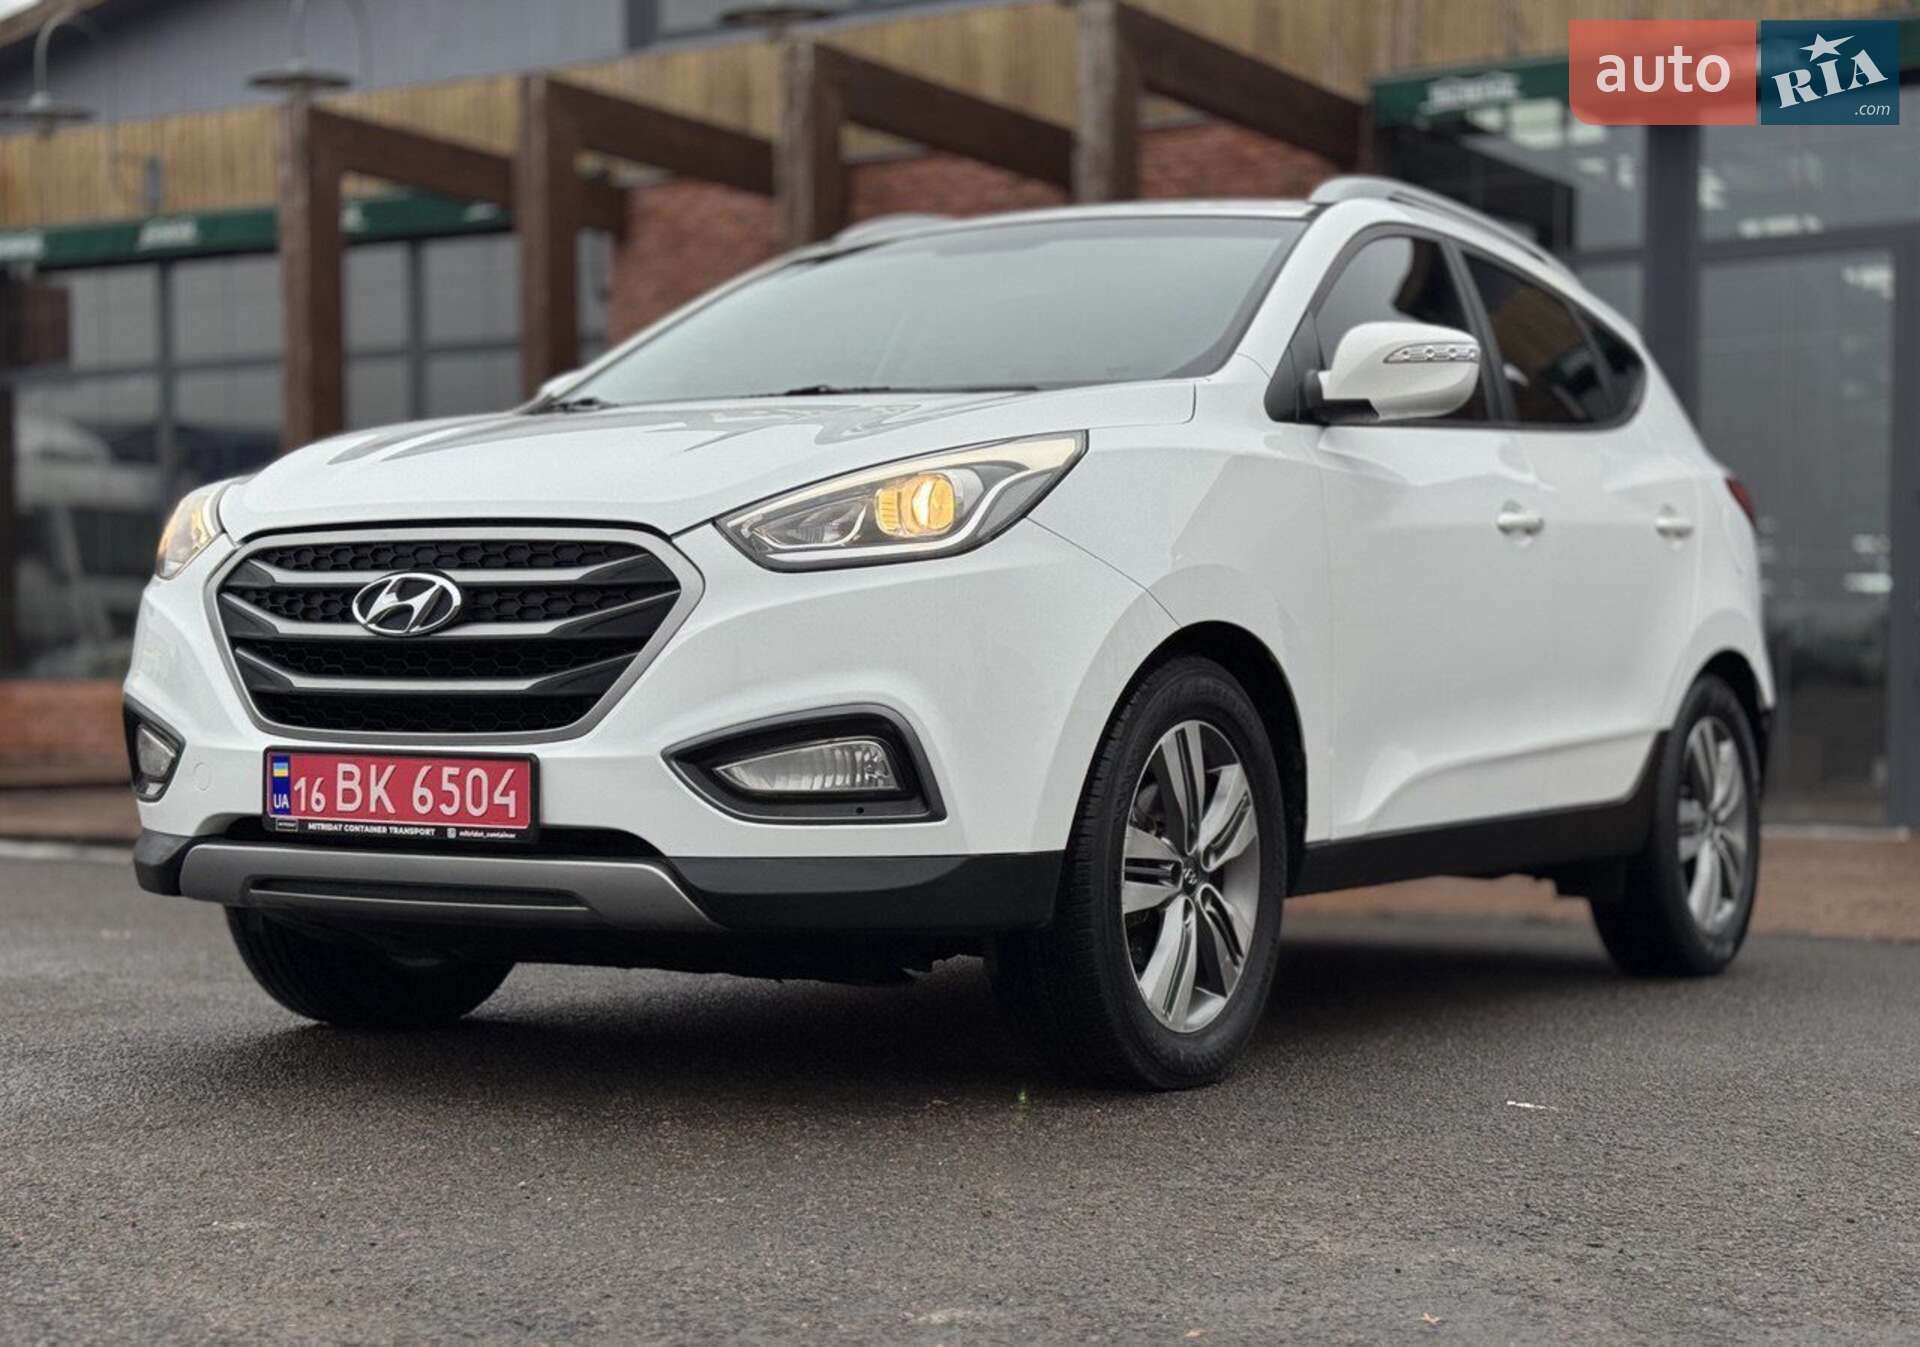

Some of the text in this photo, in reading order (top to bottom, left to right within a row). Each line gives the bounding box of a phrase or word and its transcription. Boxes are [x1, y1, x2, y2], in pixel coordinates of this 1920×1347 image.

[293, 763, 517, 818] 16 BK 6504
[273, 793, 290, 810] UA
[307, 822, 343, 832] MITRIDAT
[343, 824, 388, 834] CONTAINER
[389, 826, 436, 836] TRANSPORT
